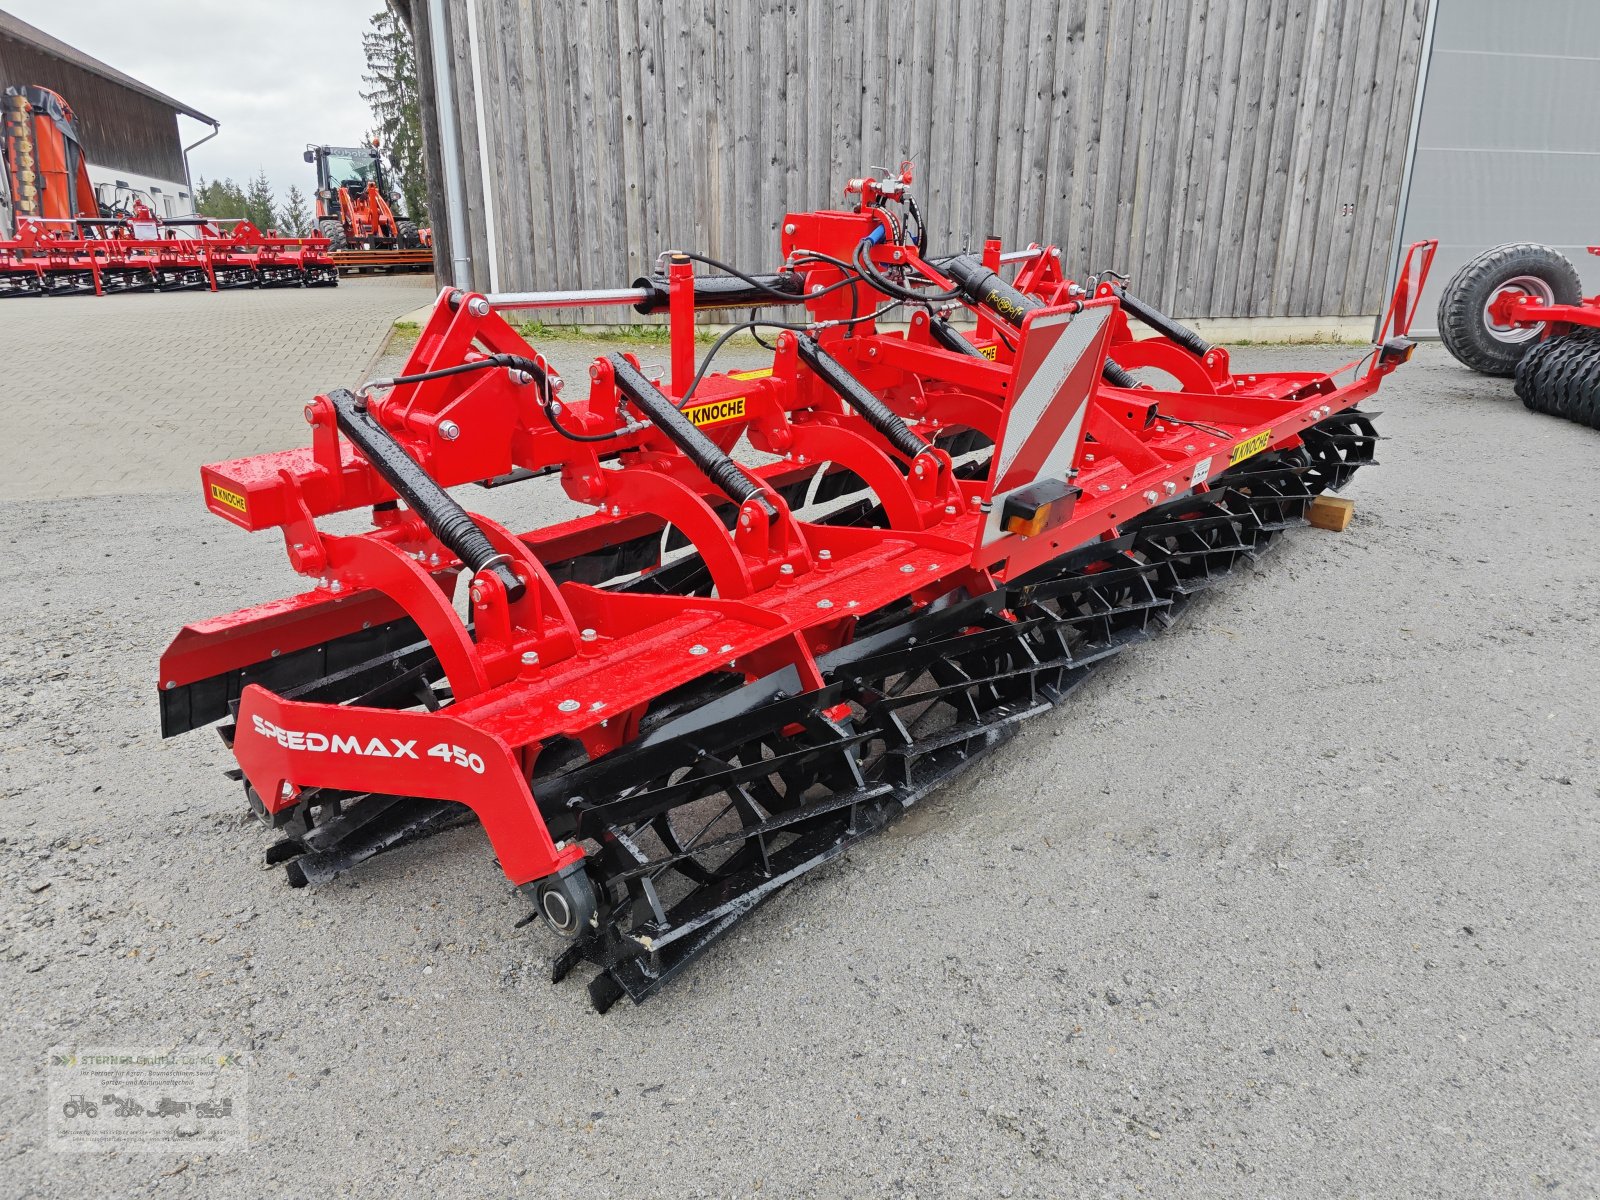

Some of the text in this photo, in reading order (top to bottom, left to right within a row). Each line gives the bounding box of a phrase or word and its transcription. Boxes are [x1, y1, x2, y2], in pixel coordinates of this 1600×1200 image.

[692, 400, 744, 424] KNOCHE
[1239, 432, 1269, 459] KNOCHE
[218, 488, 245, 510] KNOCHE
[252, 714, 485, 774] SPEEDMAX 450
